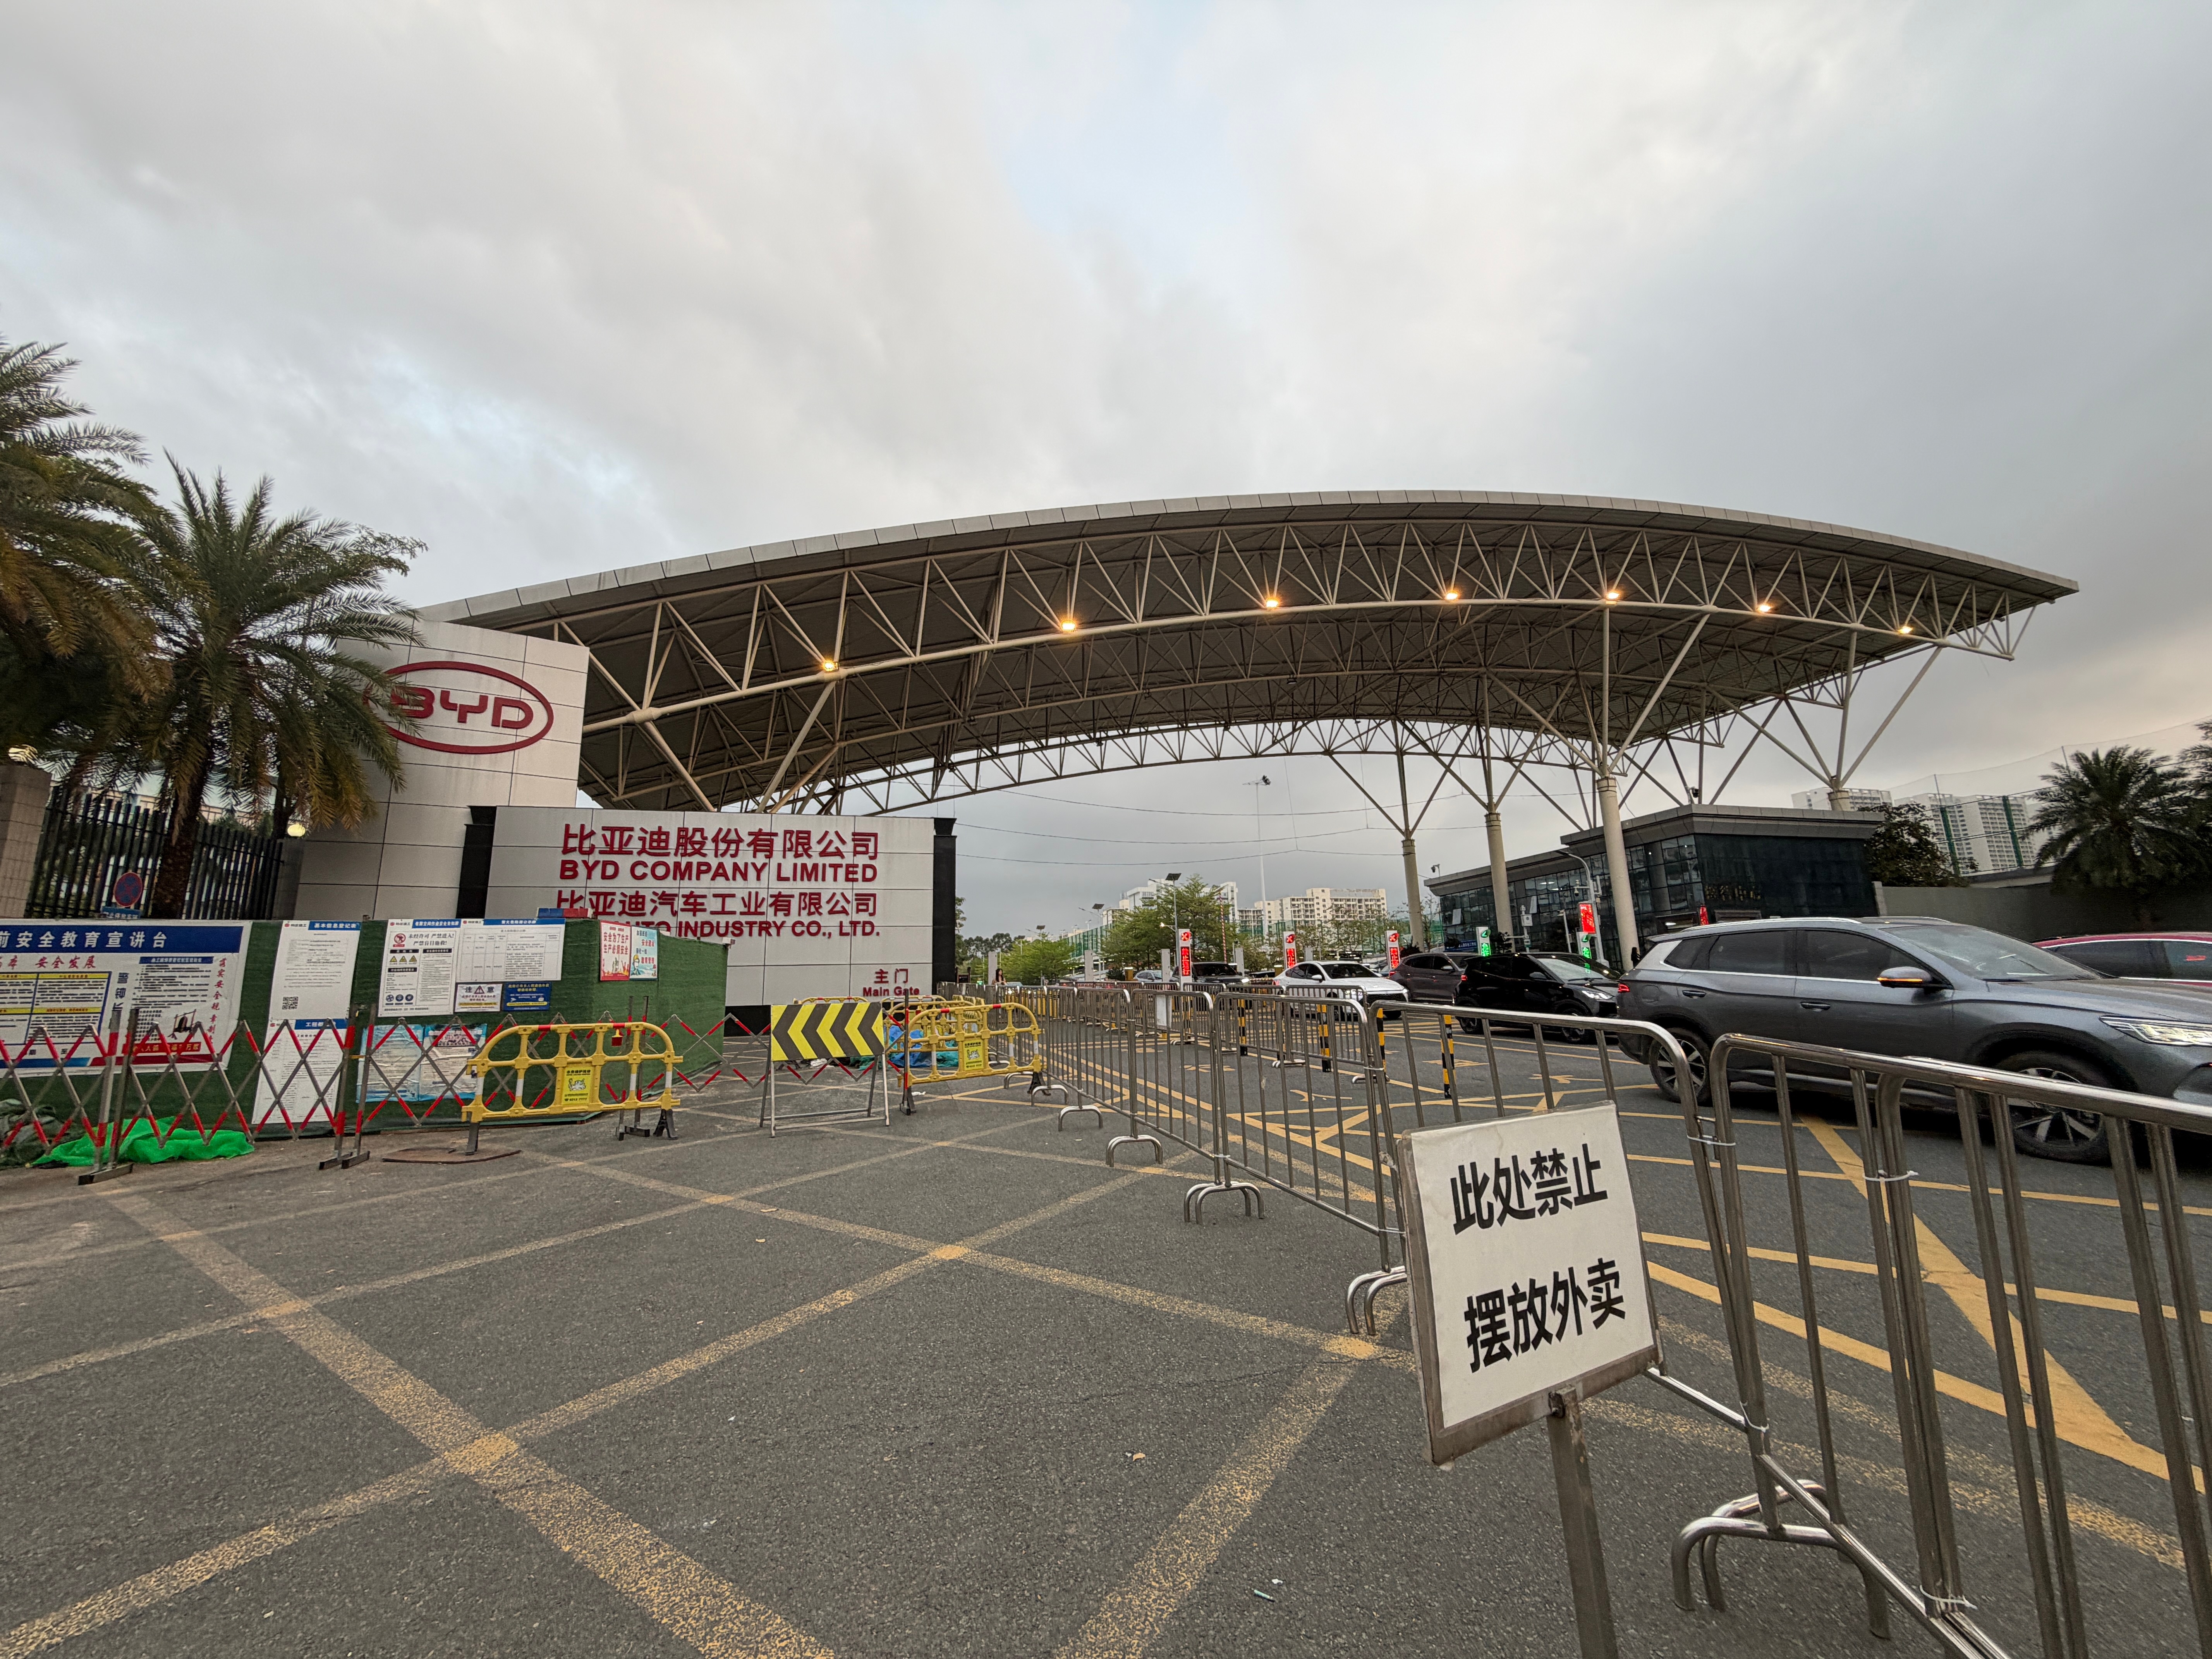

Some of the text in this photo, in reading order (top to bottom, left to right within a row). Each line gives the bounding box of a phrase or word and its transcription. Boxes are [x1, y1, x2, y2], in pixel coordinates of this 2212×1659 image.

[390, 687, 533, 729] BYD
[562, 824, 878, 860] 比亚迪股份有限公司
[560, 860, 878, 882] BYD COMPANY LIMITED
[557, 890, 876, 917] 比亚迪汽车工业有限公司
[604, 932, 629, 944] 安全为了生产
[678, 921, 786, 937] INDUSTRY
[792, 921, 832, 938] CO.,
[839, 921, 880, 936] LTD.
[35, 955, 96, 969] 安全发展
[874, 969, 908, 984] 主门
[863, 986, 919, 996] Main Gate
[1451, 1143, 1608, 1235] 此处禁止
[1464, 1257, 1626, 1374] 摆放外卖
